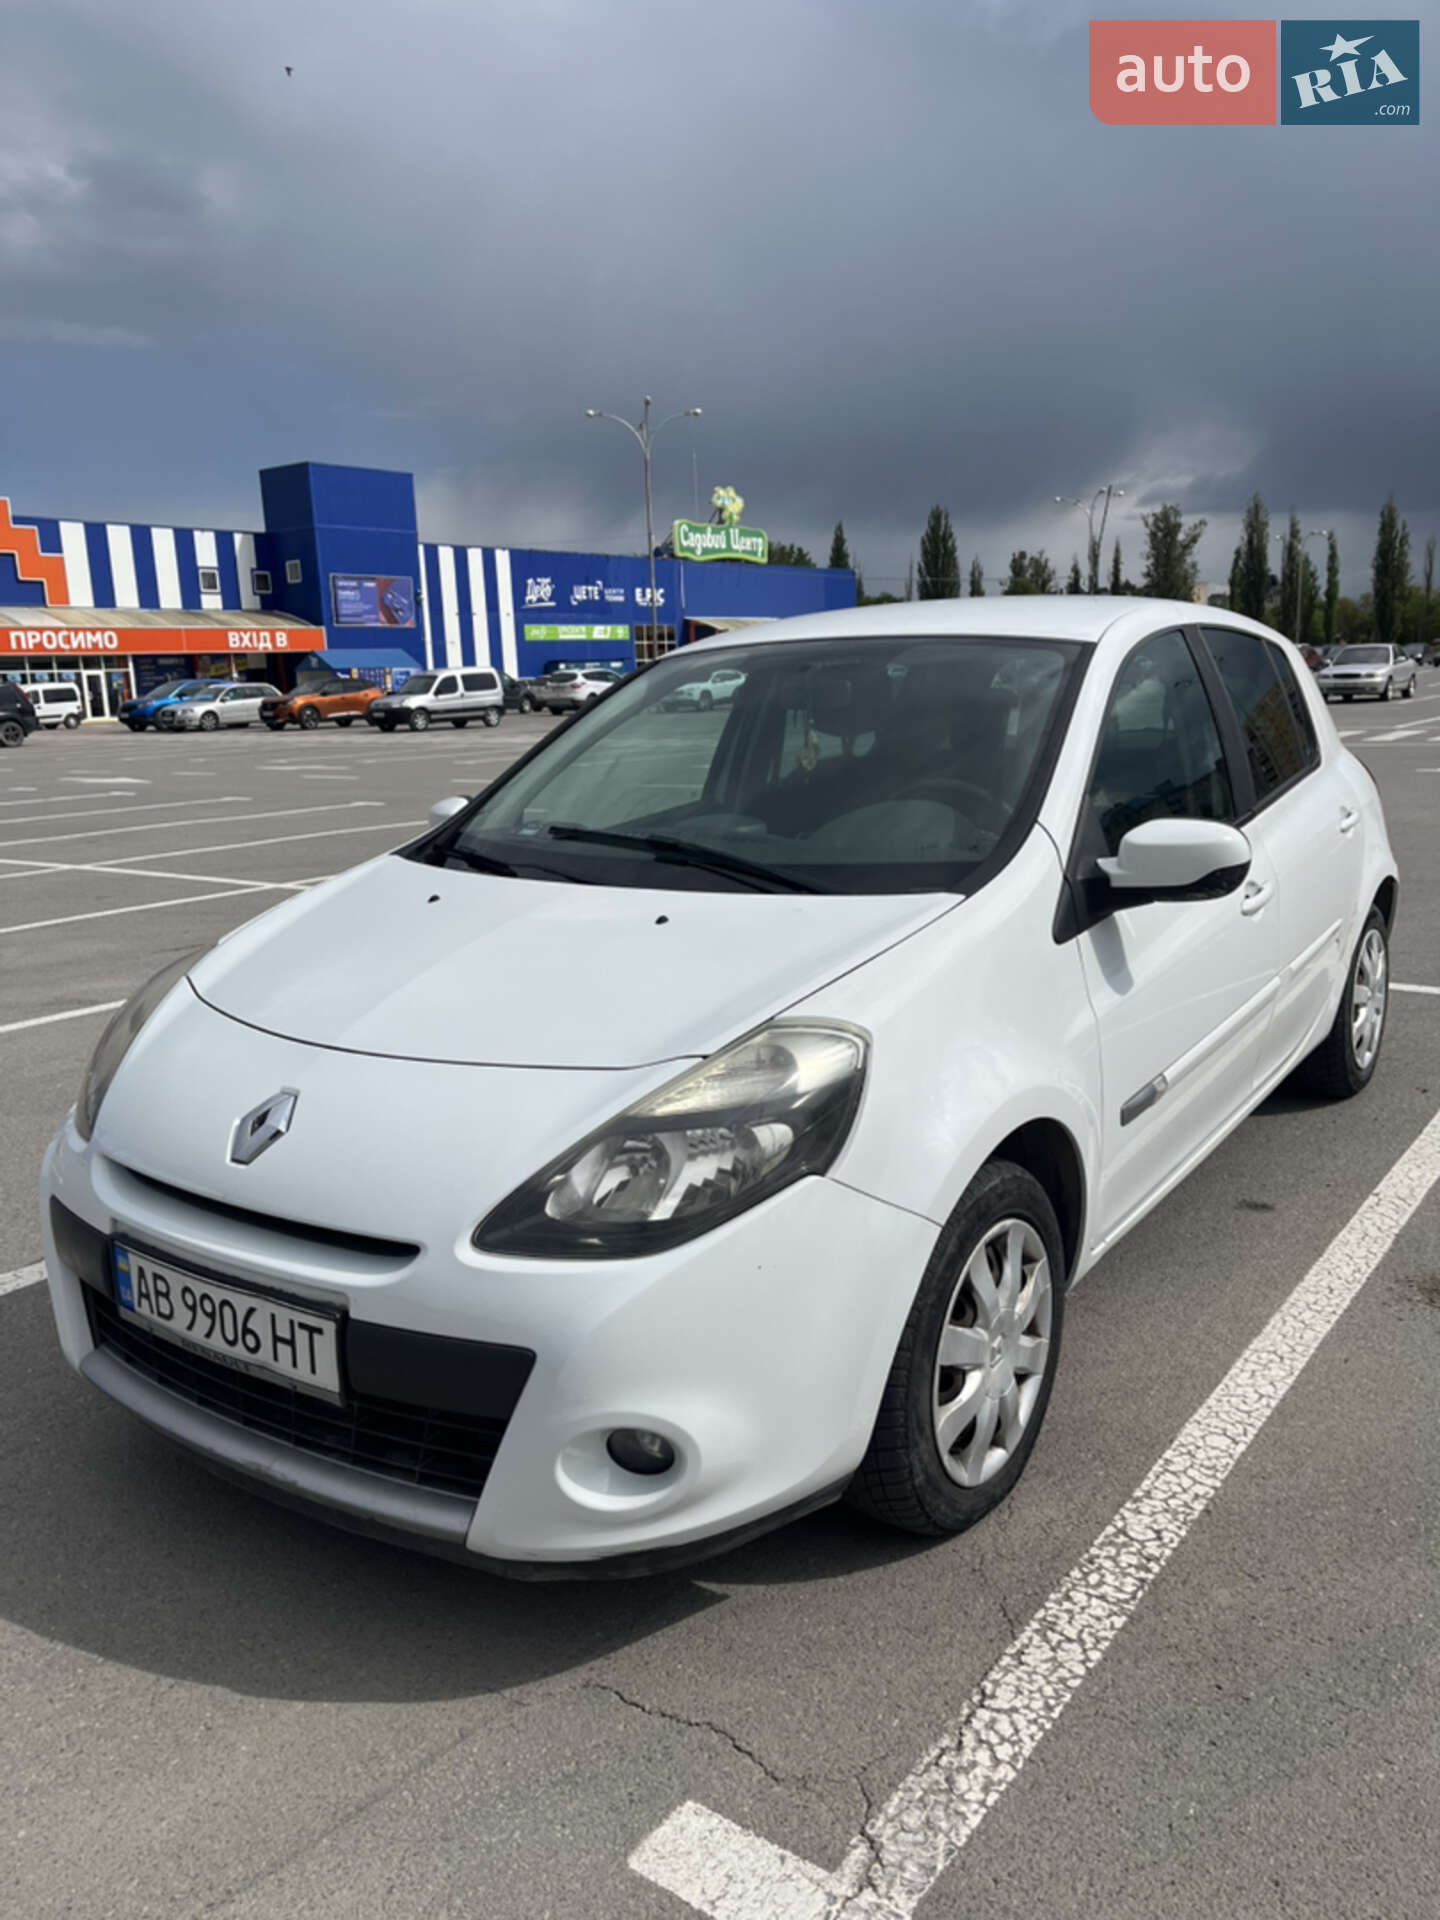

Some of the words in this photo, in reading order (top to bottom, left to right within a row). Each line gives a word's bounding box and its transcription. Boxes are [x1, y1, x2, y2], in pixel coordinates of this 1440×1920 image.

[680, 523, 727, 556] Садовий
[729, 527, 764, 558] Центр
[9, 630, 119, 650] ПРОСИМО
[228, 631, 272, 651] ВХІД
[275, 632, 288, 648] В
[137, 1265, 174, 1321] AB
[181, 1285, 261, 1355] 9906
[270, 1312, 324, 1376] HT
